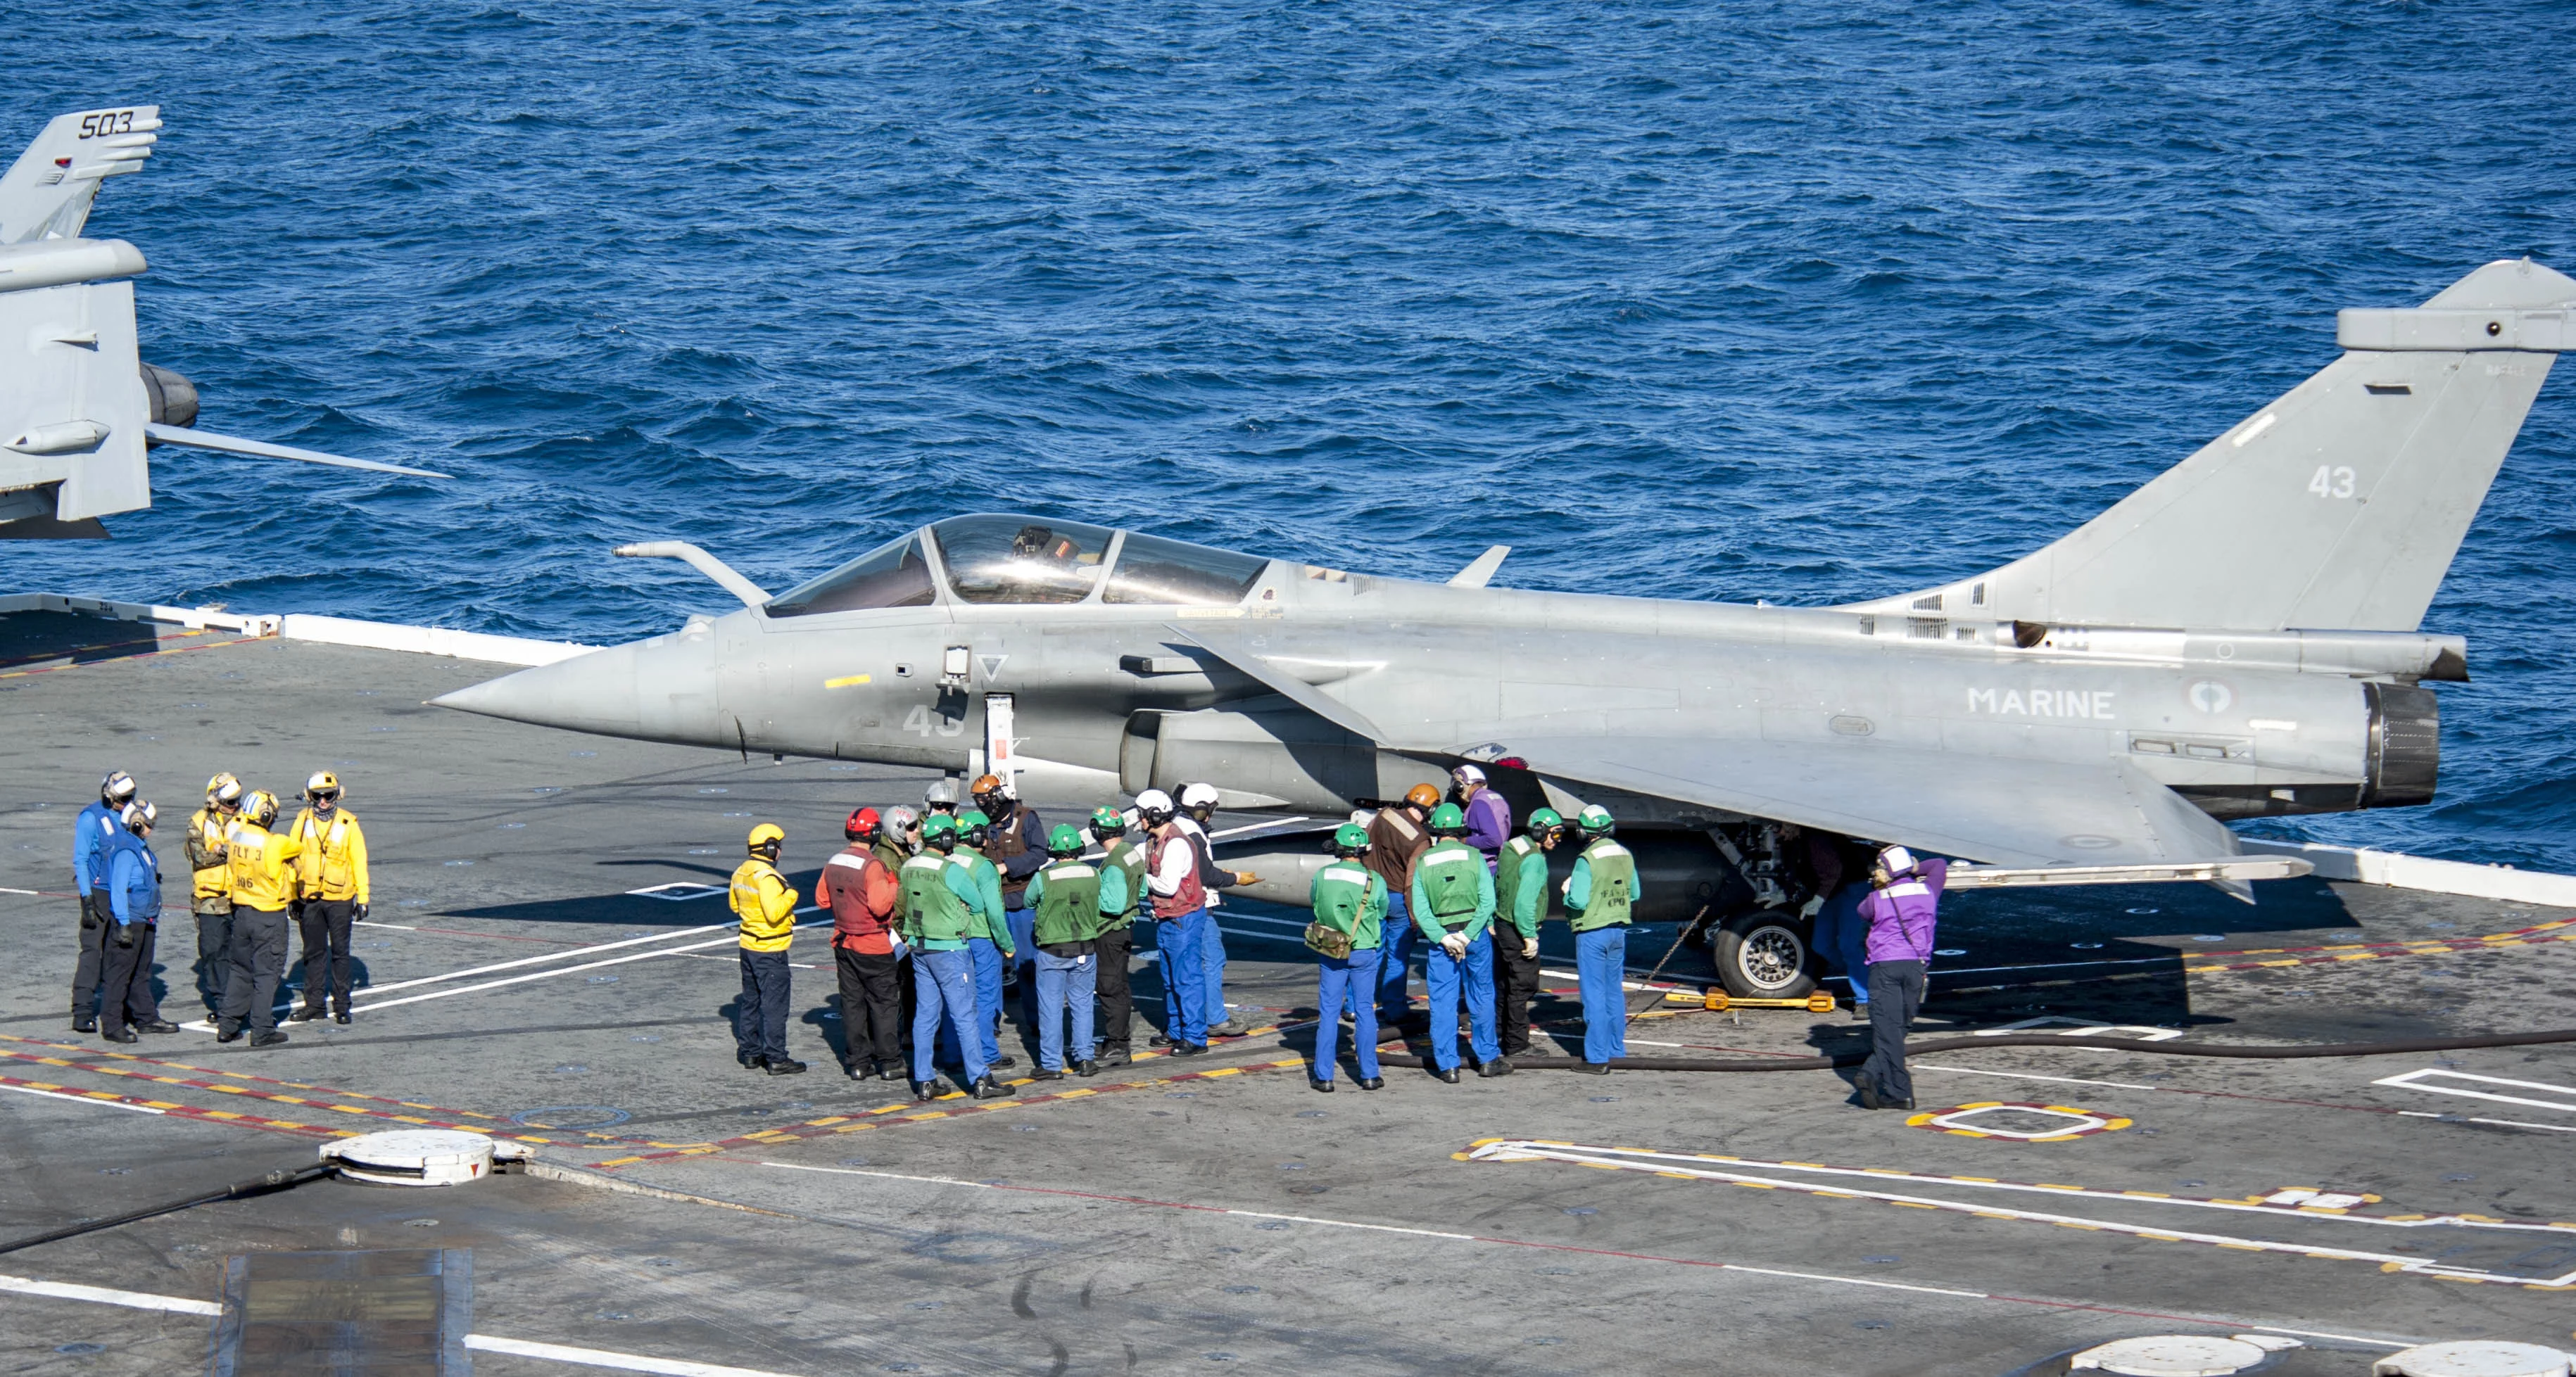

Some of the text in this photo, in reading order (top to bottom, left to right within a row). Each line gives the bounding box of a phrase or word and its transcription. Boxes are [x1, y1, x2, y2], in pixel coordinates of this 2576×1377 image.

[79, 110, 134, 139] 503
[2308, 464, 2356, 498] 43
[1967, 687, 2116, 720] MARINE
[233, 844, 263, 861] FLY 3
